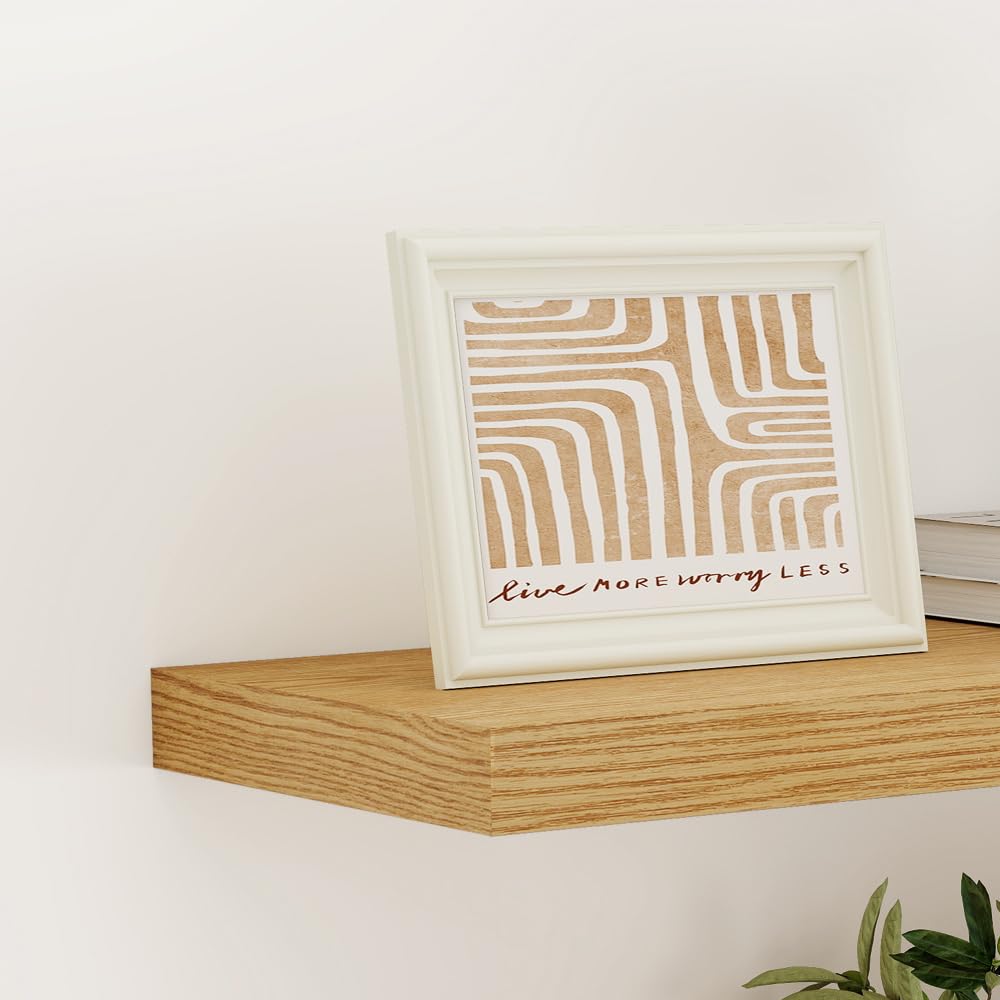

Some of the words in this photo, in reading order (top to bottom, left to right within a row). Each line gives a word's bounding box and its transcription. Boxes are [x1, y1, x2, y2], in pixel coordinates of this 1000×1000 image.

[489, 579, 587, 603] live
[593, 576, 669, 593] MORE
[678, 566, 771, 593] worry
[781, 561, 850, 579] LESS
